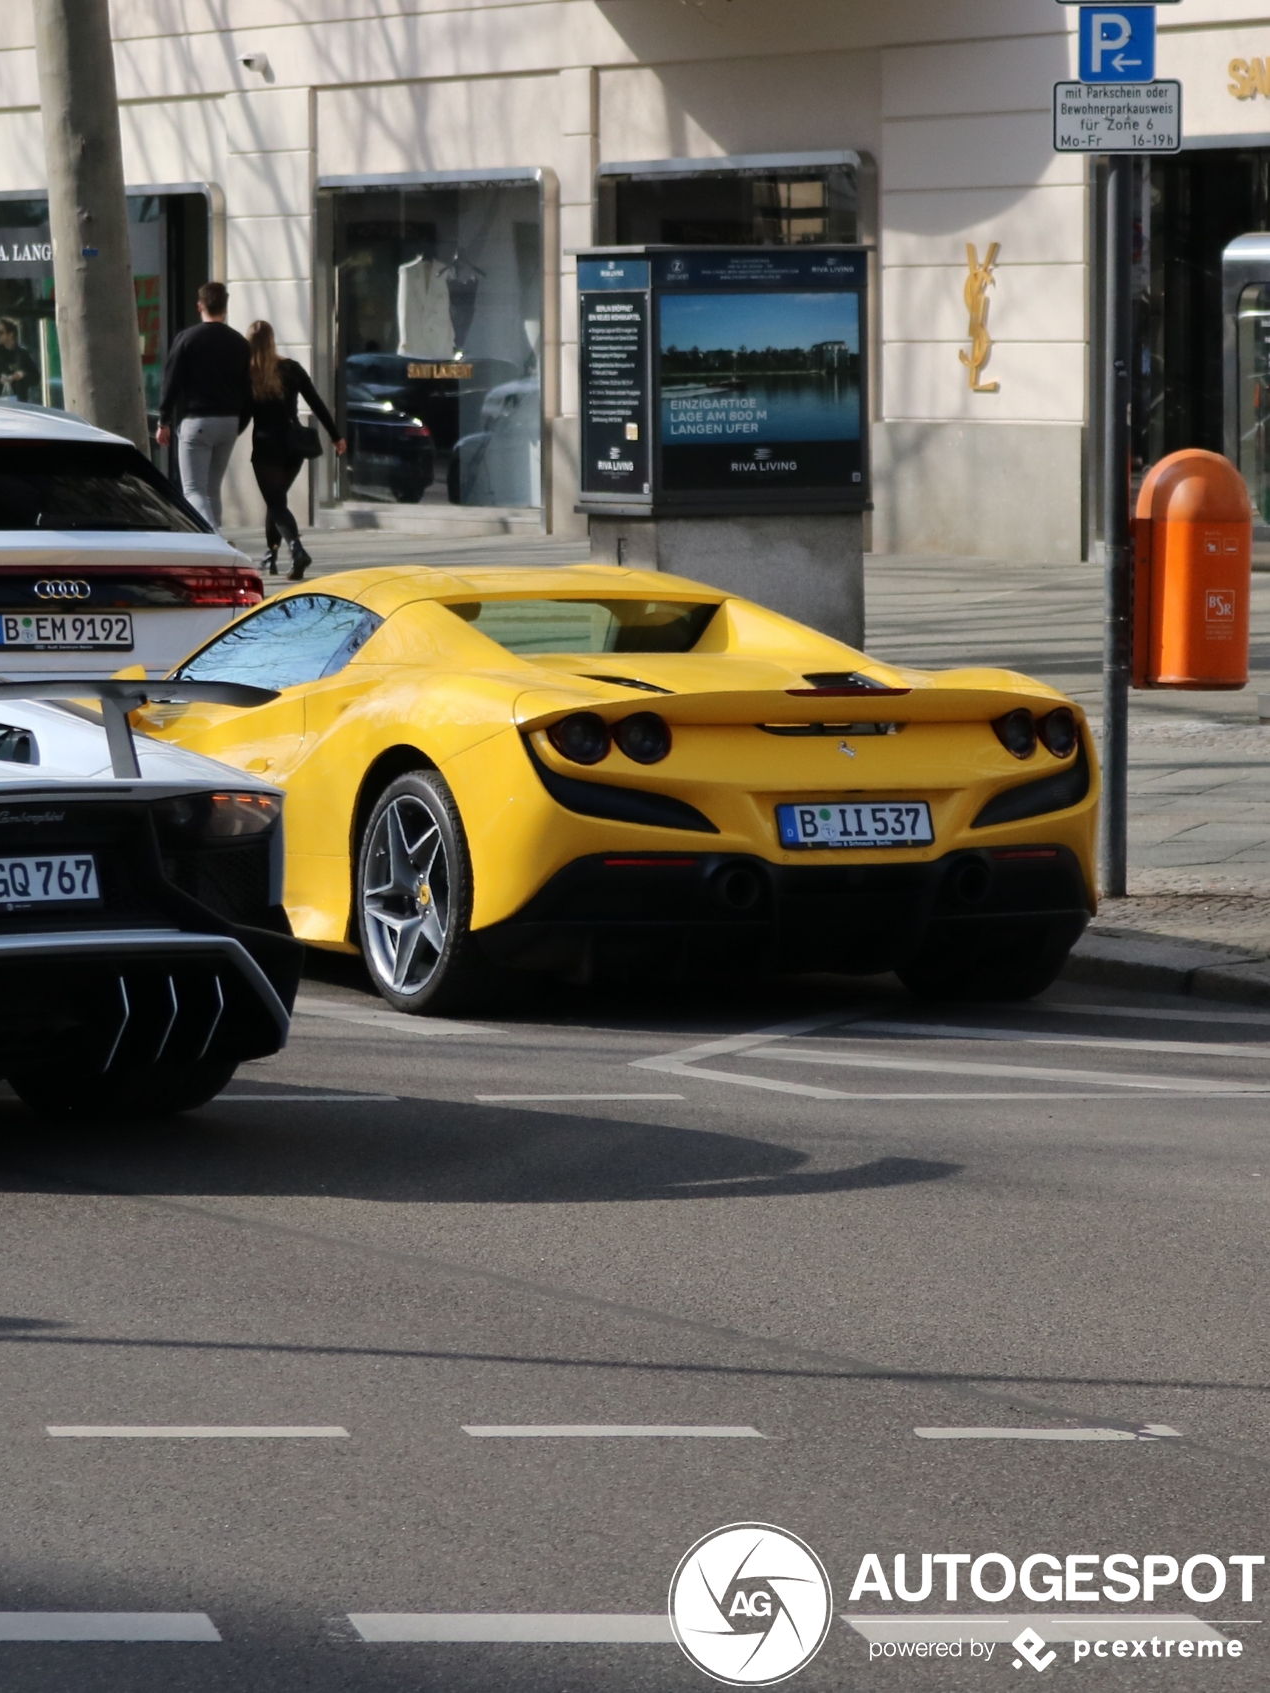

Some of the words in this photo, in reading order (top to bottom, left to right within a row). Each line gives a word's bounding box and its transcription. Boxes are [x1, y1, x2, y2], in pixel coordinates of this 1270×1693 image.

[1091, 13, 1132, 73] P
[1065, 86, 1082, 99] mit
[1086, 86, 1141, 99] Parkschein
[1146, 86, 1169, 98] oder
[1061, 102, 1173, 117] Bewohnerparkausweis
[1080, 119, 1100, 131] für
[1107, 118, 1140, 131] Zone
[1146, 119, 1154, 131] 6
[1060, 135, 1103, 147] Mo-Fr
[12, 243, 53, 261] LANG
[670, 399, 757, 410] EINZIGARTIGE
[670, 412, 703, 423] LAGE
[706, 412, 726, 422] AM
[757, 411, 767, 420] M
[670, 424, 723, 435] LANGEN
[726, 423, 759, 433] UFER
[731, 463, 757, 471] RIVA
[760, 462, 797, 471] LIVING
[1209, 596, 1232, 616] BSR
[4, 618, 20, 639] B
[36, 618, 66, 641] EM
[72, 618, 129, 641] 9192
[787, 828, 794, 838] D
[799, 809, 819, 838] B
[838, 808, 869, 837] II
[870, 807, 921, 836] 537
[34, 859, 93, 896] 767
